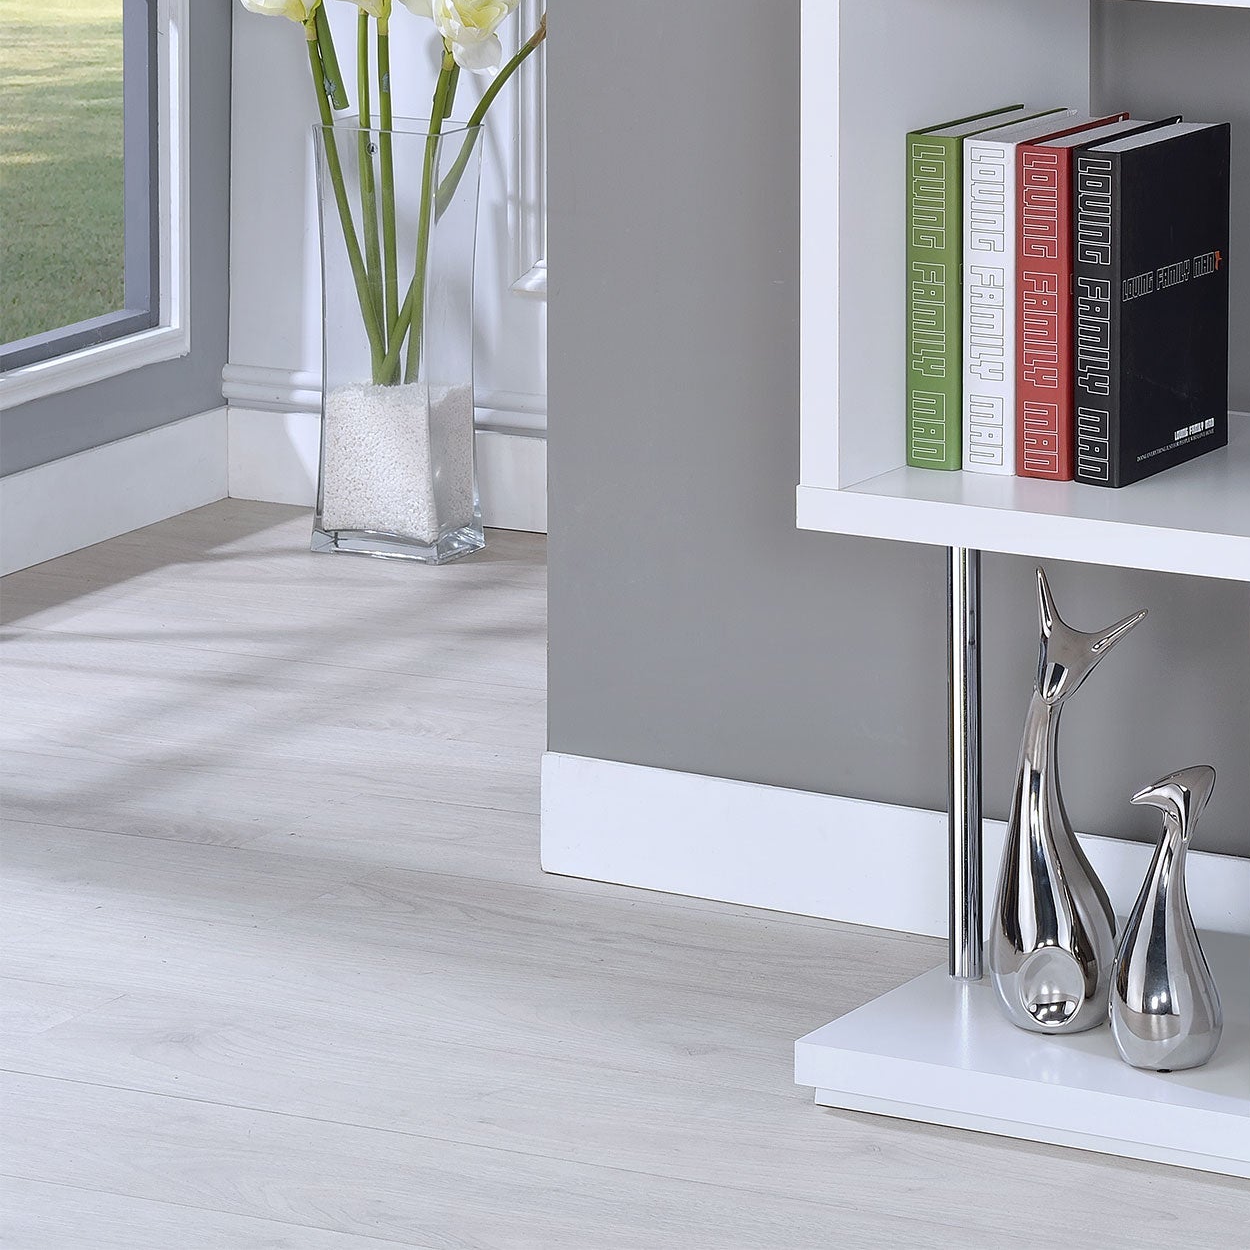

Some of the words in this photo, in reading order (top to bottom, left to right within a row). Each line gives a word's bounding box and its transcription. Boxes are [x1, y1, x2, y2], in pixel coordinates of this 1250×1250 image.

[912, 261, 945, 378] FAMILY
[970, 264, 1004, 382] FAMILY
[1023, 271, 1058, 388] FAMILY
[1077, 276, 1111, 396] FAMILY
